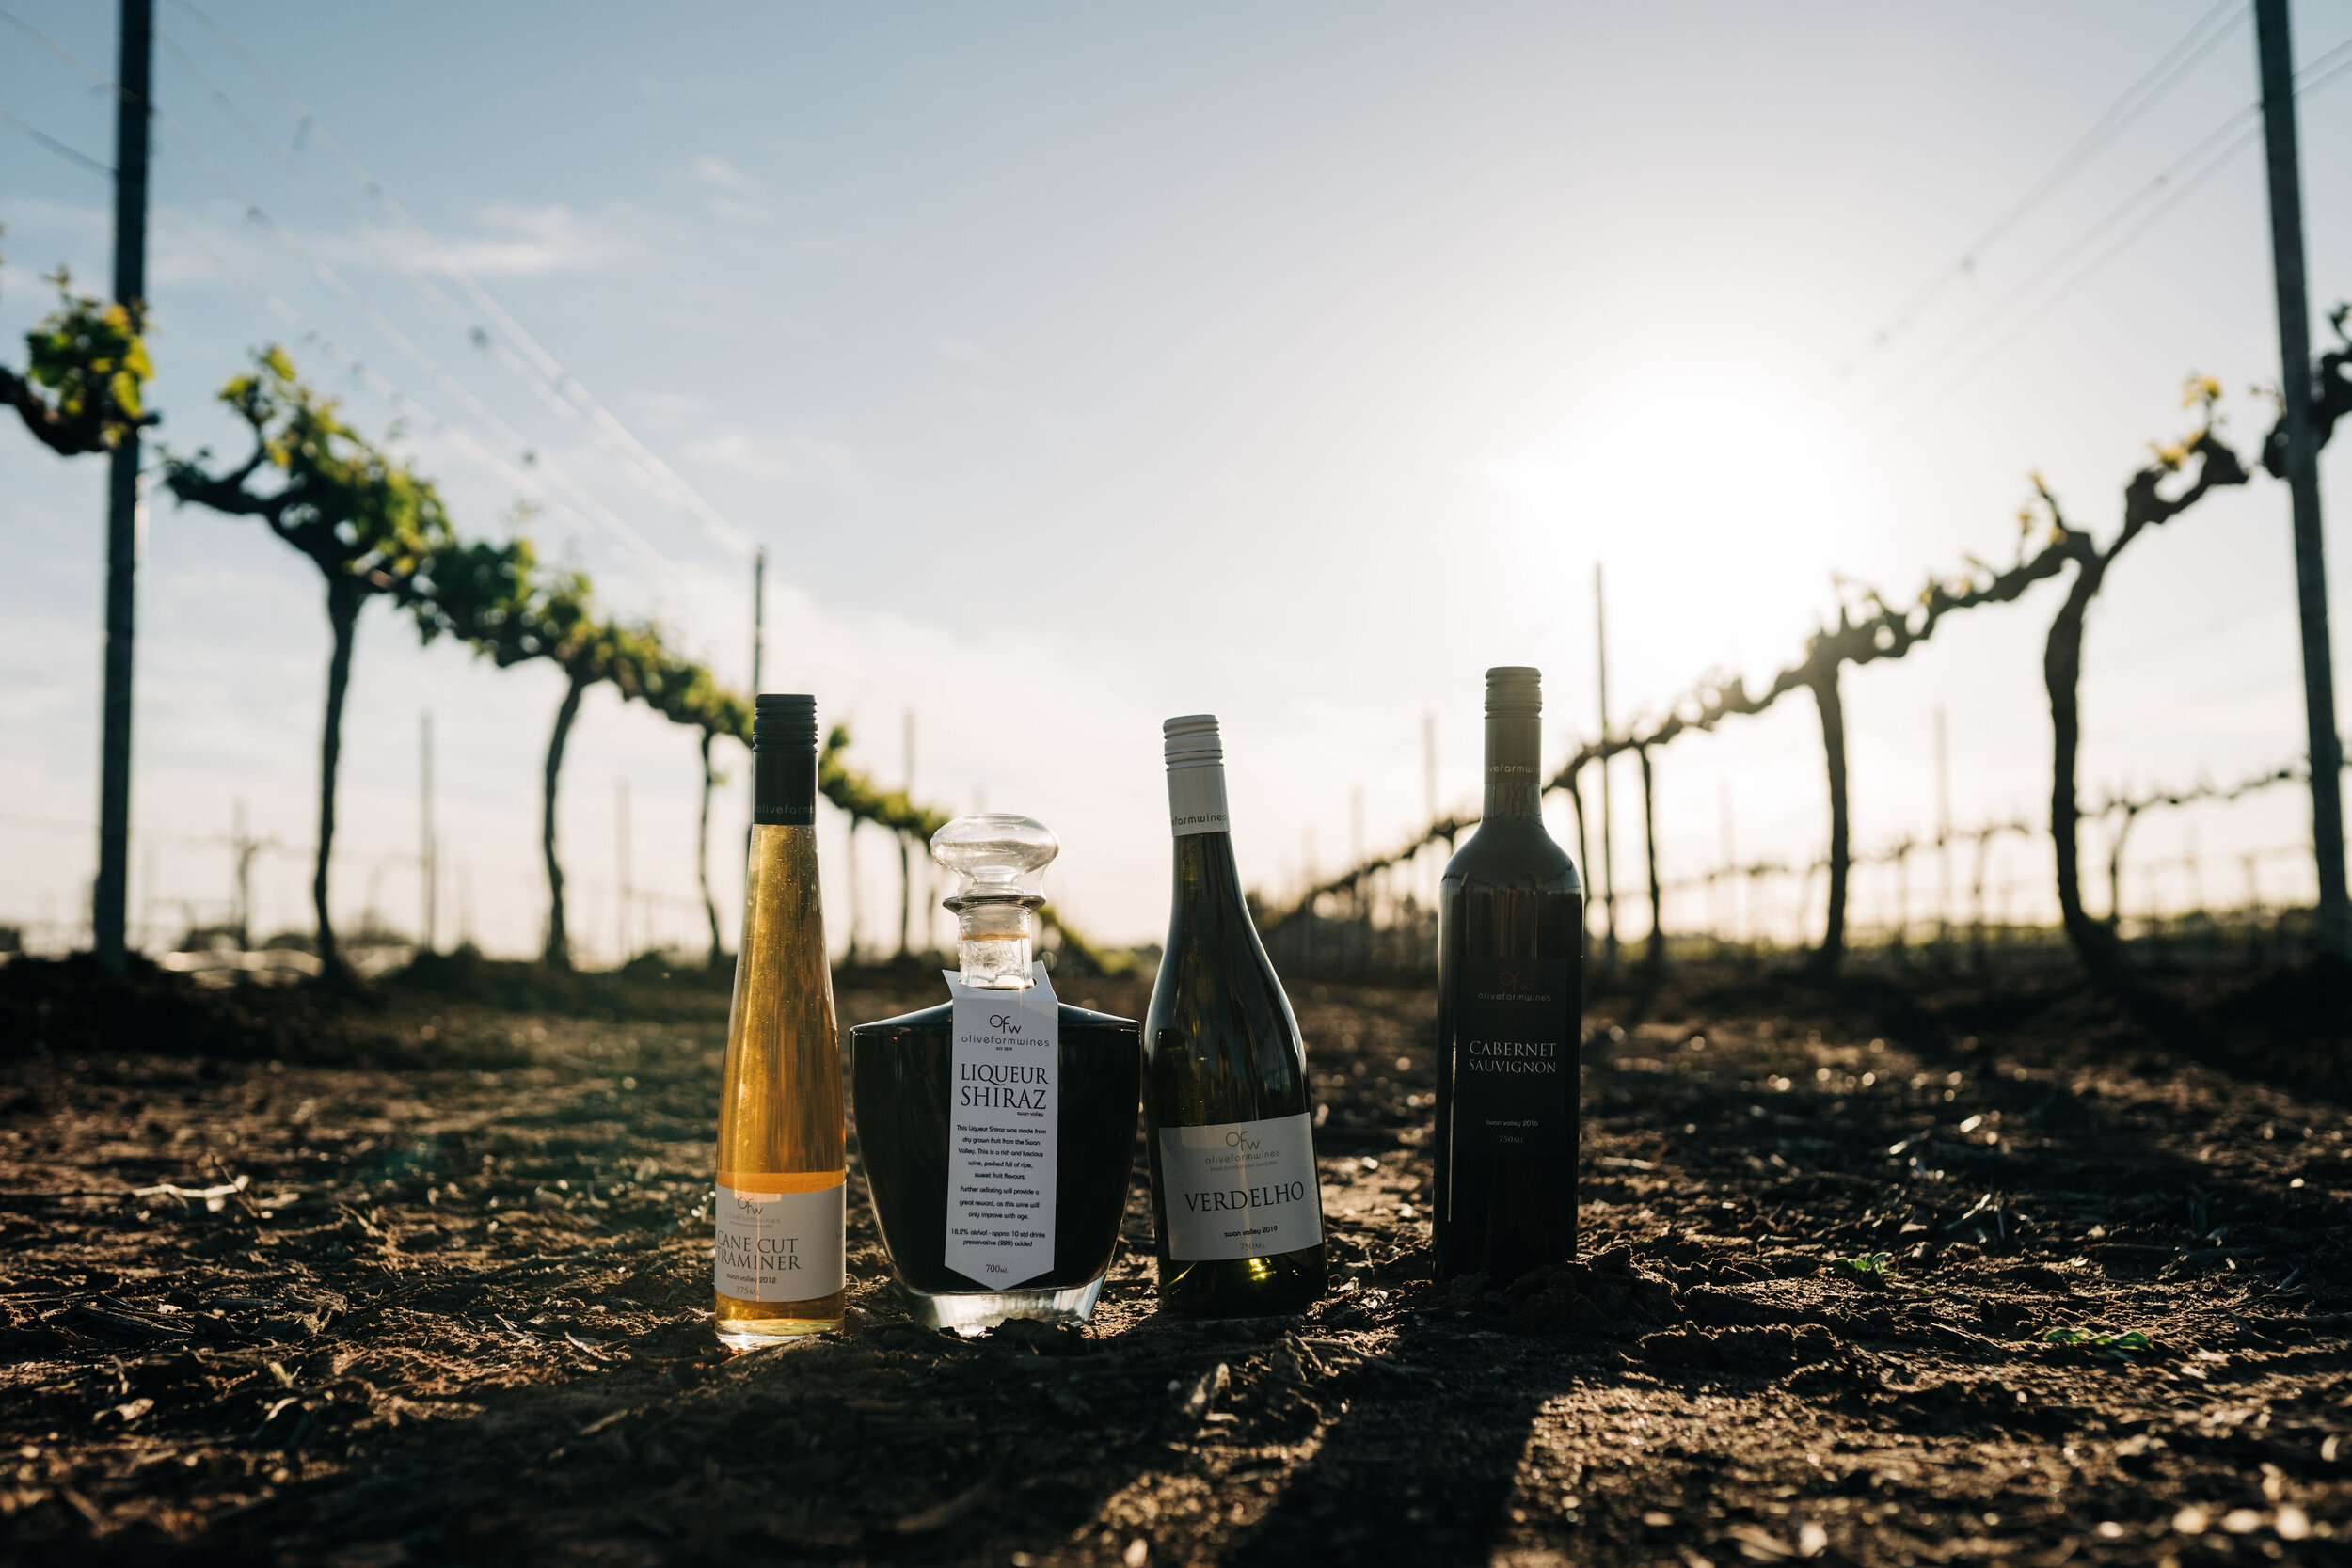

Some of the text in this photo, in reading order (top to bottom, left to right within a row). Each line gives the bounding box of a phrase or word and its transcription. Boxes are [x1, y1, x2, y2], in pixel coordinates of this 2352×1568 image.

[1487, 763, 1539, 773] vefarmwi
[1477, 991, 1551, 1002] olivefarmwines
[961, 1035, 1050, 1047] olivefarmwines
[1470, 1040, 1557, 1057] CABERNET
[1469, 1059, 1556, 1074] SAUVIGNON
[961, 1063, 1050, 1085] LIQUEUR
[961, 1085, 1047, 1110] SHIRAZ
[1502, 1119, 1521, 1128] valley
[1499, 1135, 1525, 1144] 750ML
[1205, 1150, 1280, 1164] olivefarmwines
[1183, 1181, 1304, 1212] VERDELHO
[723, 1211, 782, 1225] ovefarmwines
[1242, 1227, 1262, 1236] valley
[1262, 1225, 1279, 1234] 2019
[717, 1229, 799, 1254] CANE CUT
[1239, 1241, 1266, 1251] 750ML
[716, 1245, 802, 1270] TRAMINER
[986, 1264, 1009, 1273] 700ML
[740, 1275, 758, 1284] valley
